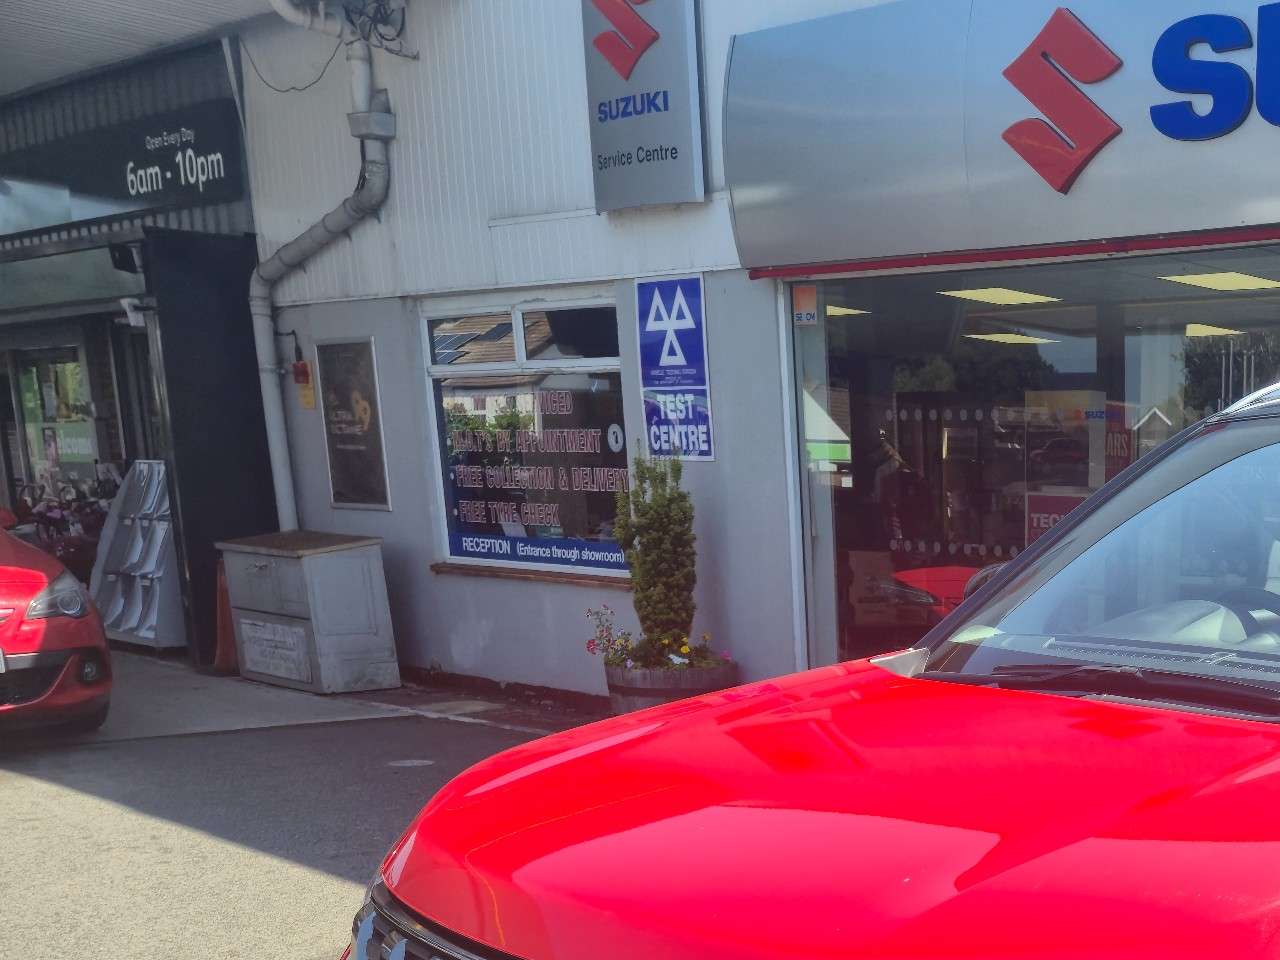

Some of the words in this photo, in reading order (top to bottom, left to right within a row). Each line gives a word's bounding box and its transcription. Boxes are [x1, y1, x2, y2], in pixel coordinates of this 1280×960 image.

[597, 90, 670, 123] SUZUKI
[597, 149, 633, 170] Service
[636, 145, 679, 164] Centre
[126, 161, 163, 196] 6am
[175, 147, 225, 193] 10pm
[656, 393, 695, 420] TEST
[515, 428, 601, 453] APPOINTMENT
[650, 424, 709, 451] CENTRE
[1107, 432, 1128, 457] ARS
[456, 465, 483, 488] FREE
[486, 465, 554, 490] COLLECTION
[571, 467, 629, 492] DELIVERY
[459, 500, 487, 523] FREE
[520, 503, 560, 527] CHECK
[1030, 513, 1065, 529] TEC
[462, 537, 511, 555] RECEPTION
[516, 541, 551, 558] (Entrance
[551, 544, 580, 563] through
[581, 547, 625, 564] showroom)
